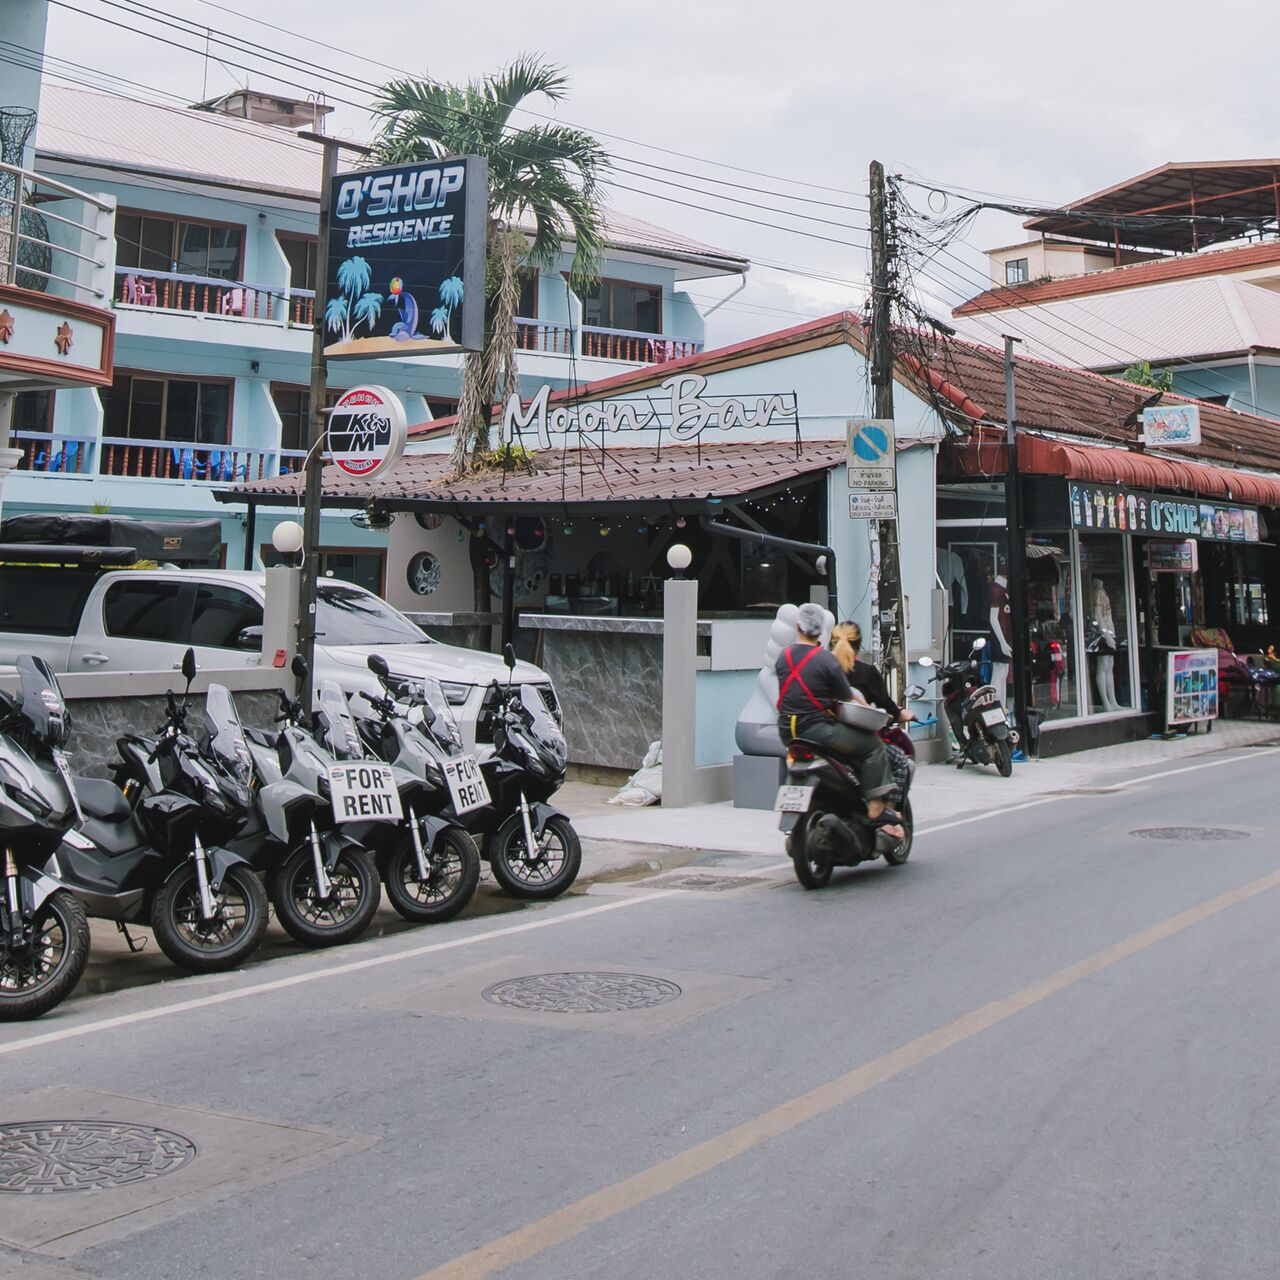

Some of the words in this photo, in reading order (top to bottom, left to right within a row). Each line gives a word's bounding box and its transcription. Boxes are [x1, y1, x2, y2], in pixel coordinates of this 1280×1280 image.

[336, 166, 465, 220] O'SHOP
[346, 214, 454, 248] RESIDENCE
[502, 384, 655, 449] Moon
[662, 374, 798, 440] Bar
[346, 768, 384, 789] FOR
[455, 758, 478, 782] FOR
[343, 794, 392, 816] RENT
[457, 781, 487, 808] RENT
